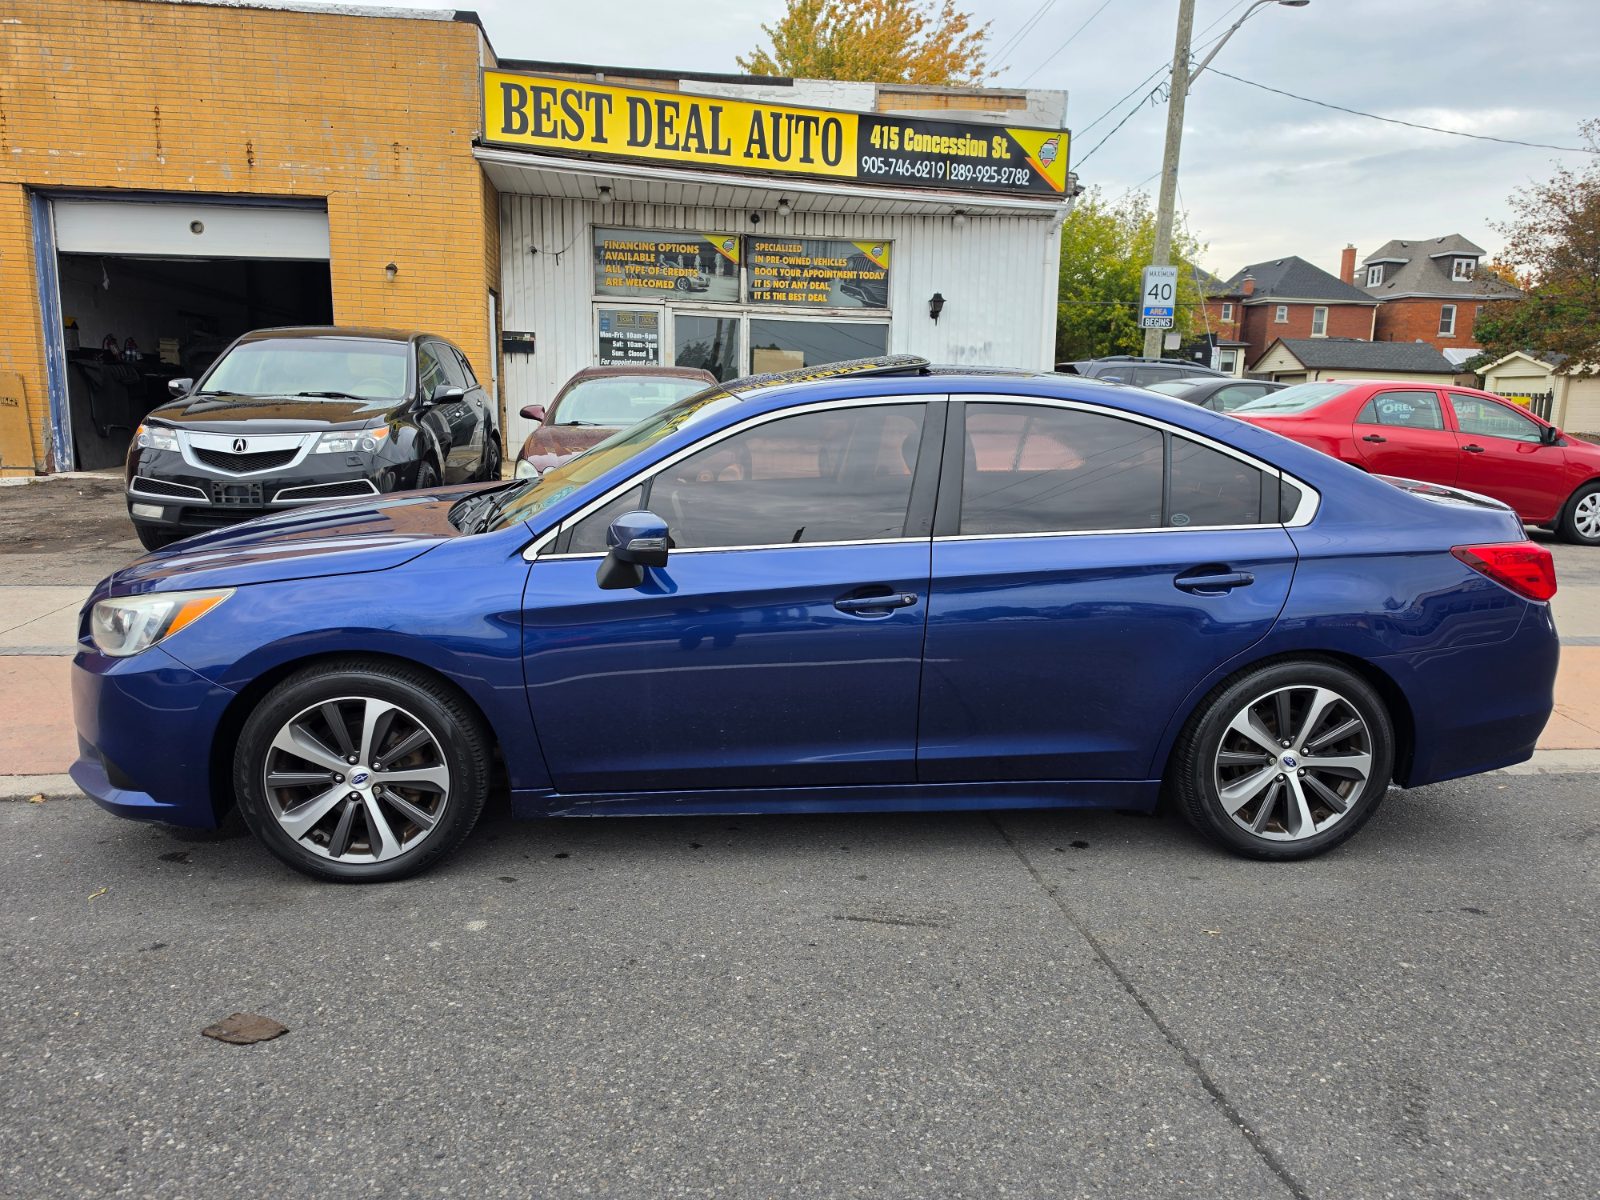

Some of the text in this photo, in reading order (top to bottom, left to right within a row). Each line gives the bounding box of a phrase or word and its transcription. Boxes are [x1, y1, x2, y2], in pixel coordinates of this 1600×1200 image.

[499, 81, 843, 168] BEST DEAL AUTO
[870, 125, 1011, 159] 415 Concession St.
[861, 156, 1030, 186] 905-746-6219 289-925-2782
[604, 240, 700, 254] FINANCING OPTIONS
[755, 243, 803, 253] SPECIALIZED
[604, 252, 656, 262] AVAILABLE
[766, 256, 811, 266] PRE-OWNED
[813, 258, 847, 267] VEHICLES
[605, 265, 698, 278] ALL TYPE OF CREDITS
[754, 267, 885, 280] BOOK YOUR APPOINTMENT TODAY
[605, 278, 675, 289] ARE WELCOMED
[754, 280, 762, 288] IT
[763, 280, 771, 288] IS
[773, 280, 789, 289] NOT
[791, 281, 808, 290] ANY
[754, 291, 828, 302] IT IS THE BEST DEAL
[1147, 283, 1172, 300] 40
[1145, 318, 1171, 327] BEGINS
[611, 349, 625, 357] Sun:
[600, 358, 610, 366] For
